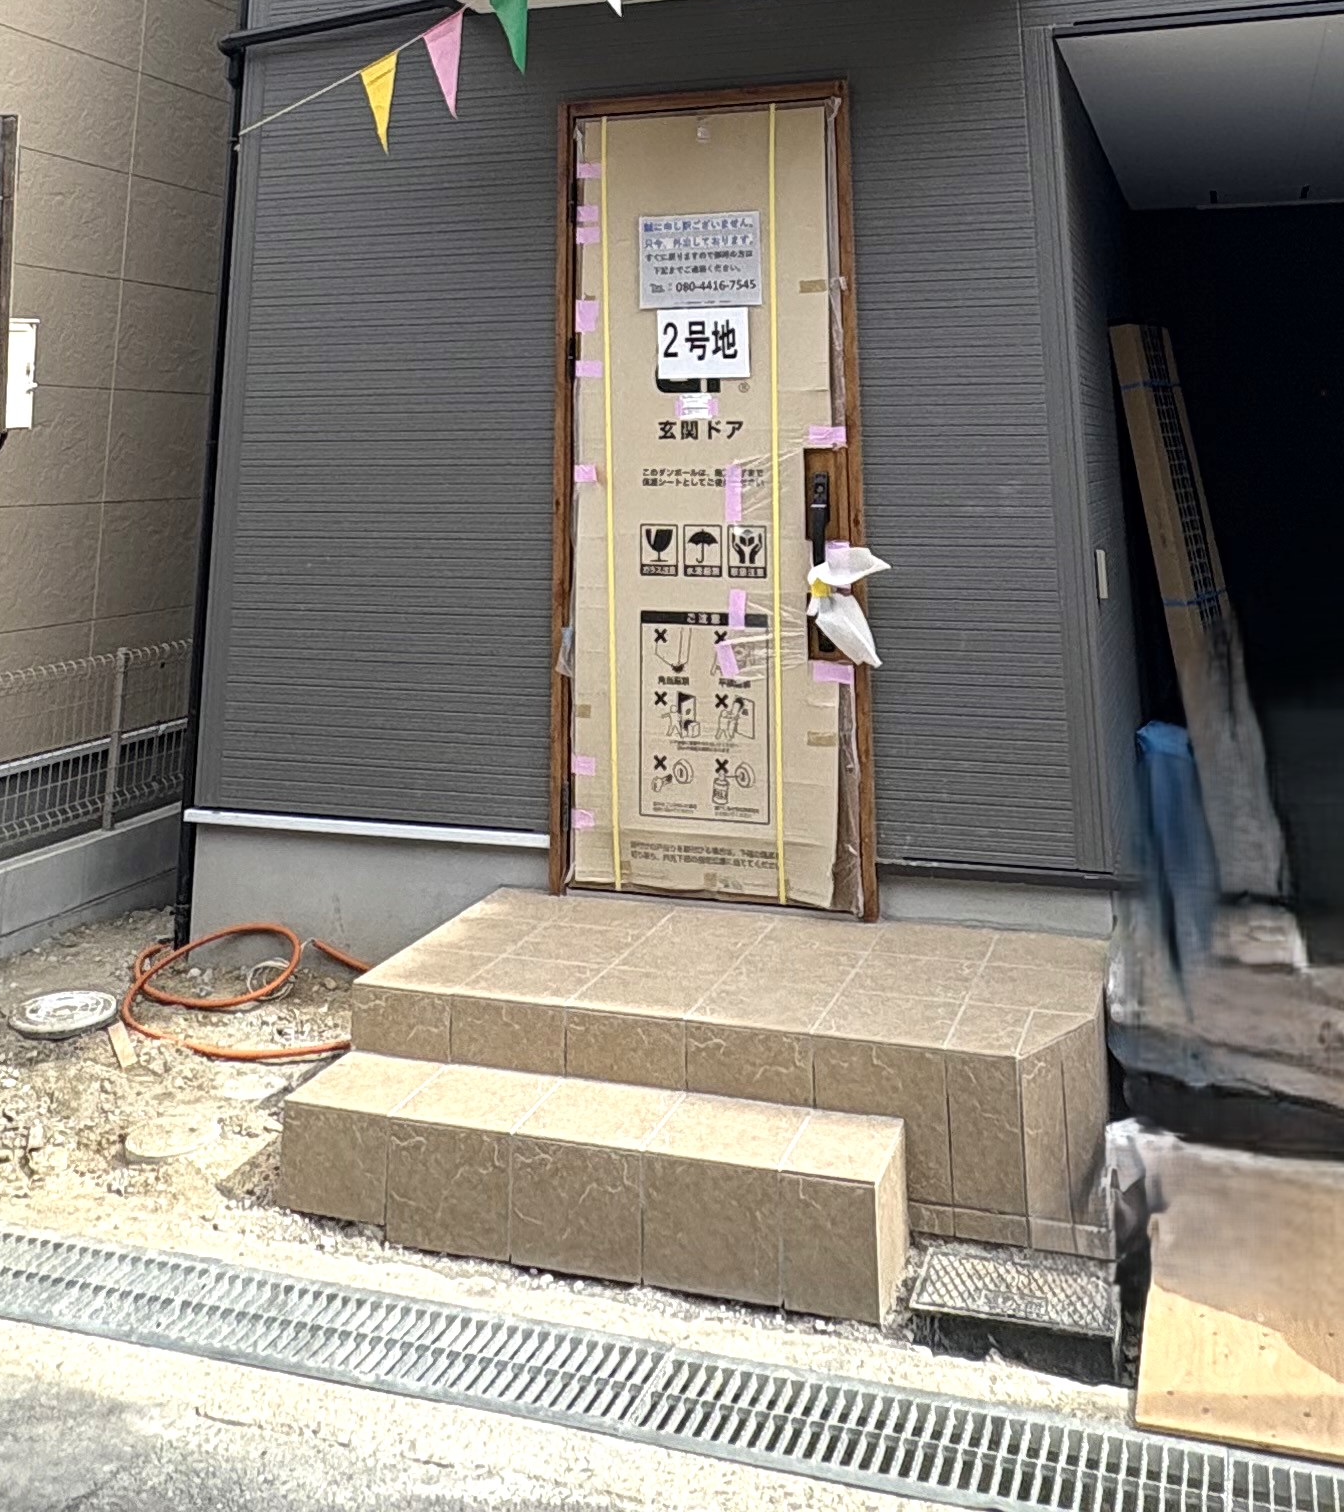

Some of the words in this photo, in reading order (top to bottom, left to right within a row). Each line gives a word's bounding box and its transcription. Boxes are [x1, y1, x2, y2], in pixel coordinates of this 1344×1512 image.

[676, 278, 757, 293] 080-4416-7545
[662, 319, 738, 361] 2号地
[657, 419, 744, 441] 玄関ドア
